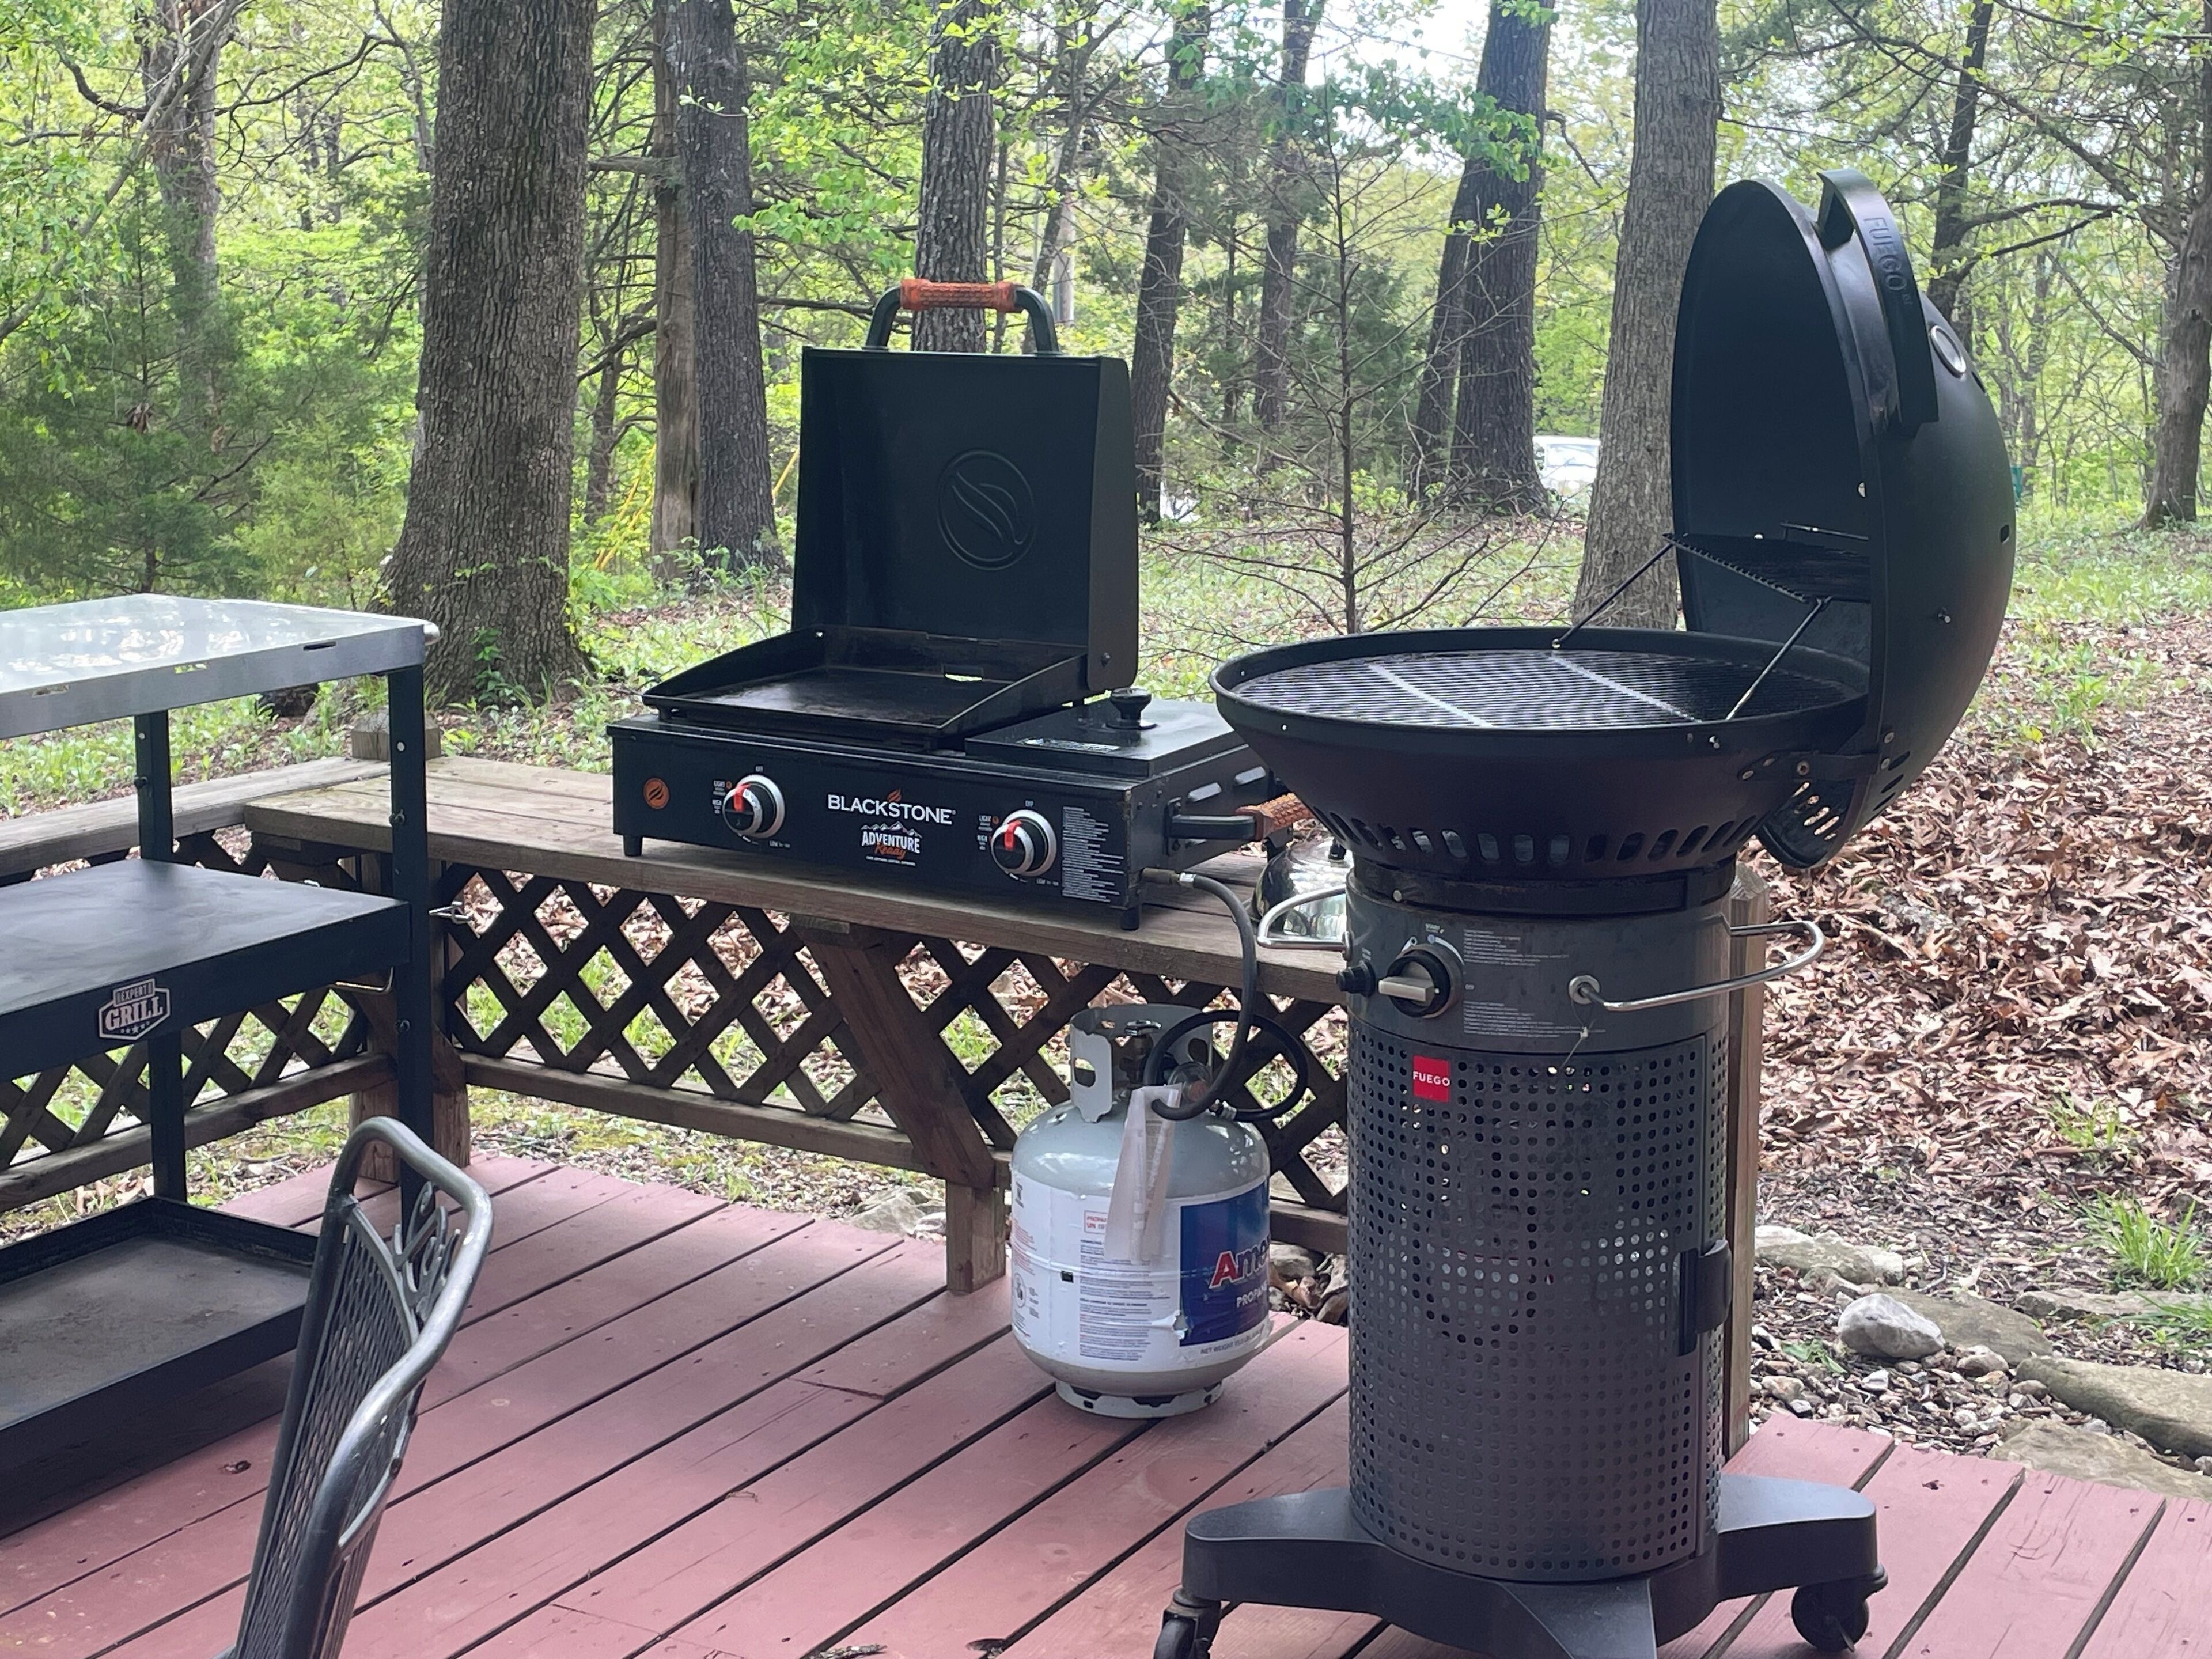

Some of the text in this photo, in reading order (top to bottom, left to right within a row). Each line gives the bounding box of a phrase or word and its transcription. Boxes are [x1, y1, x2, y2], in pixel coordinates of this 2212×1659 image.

[1863, 217, 1907, 291] FUEGO
[861, 831, 921, 854] ADVENTURE
[120, 984, 148, 1002] EXPERT
[105, 996, 164, 1031] GRILL
[1413, 1071, 1450, 1086] FUEGO
